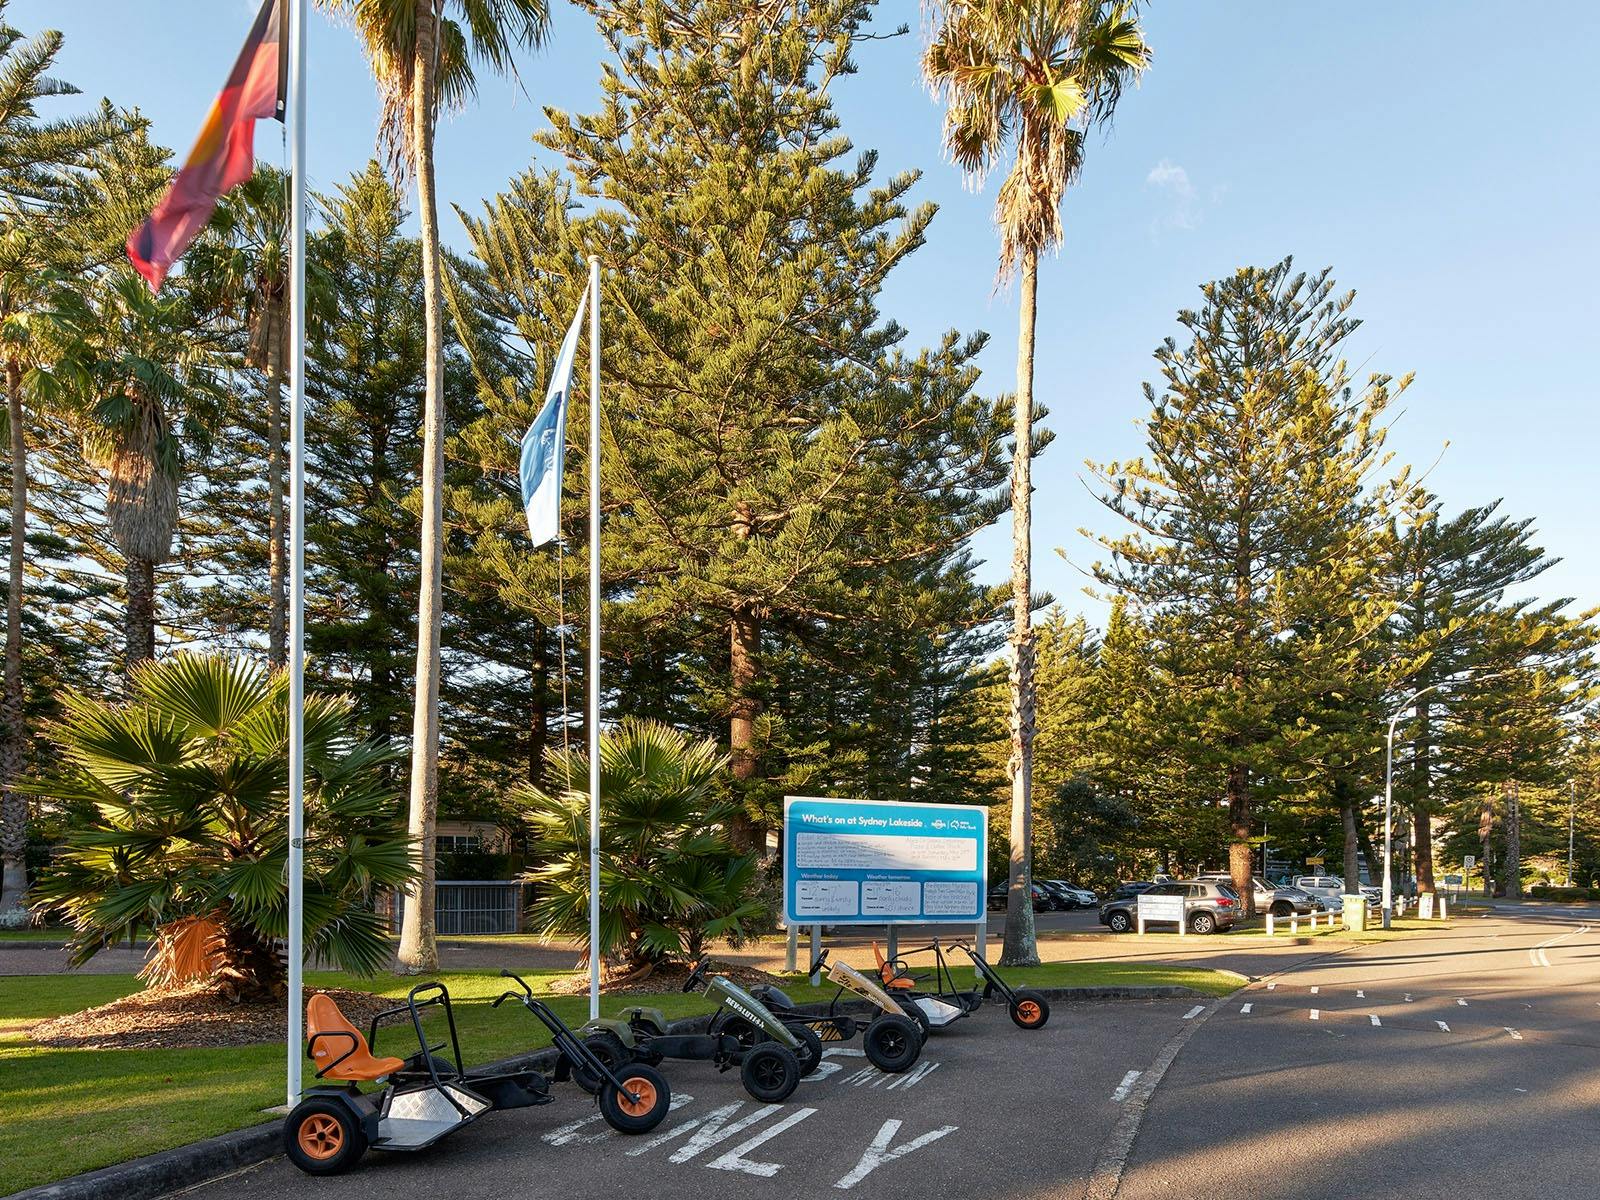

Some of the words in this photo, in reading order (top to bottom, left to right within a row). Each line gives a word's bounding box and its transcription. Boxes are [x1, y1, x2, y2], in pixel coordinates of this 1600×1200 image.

[802, 814, 833, 824] What's
[835, 817, 846, 825] on
[847, 816, 857, 825] at
[858, 816, 887, 828] Sydney
[889, 817, 923, 828] Lakeside
